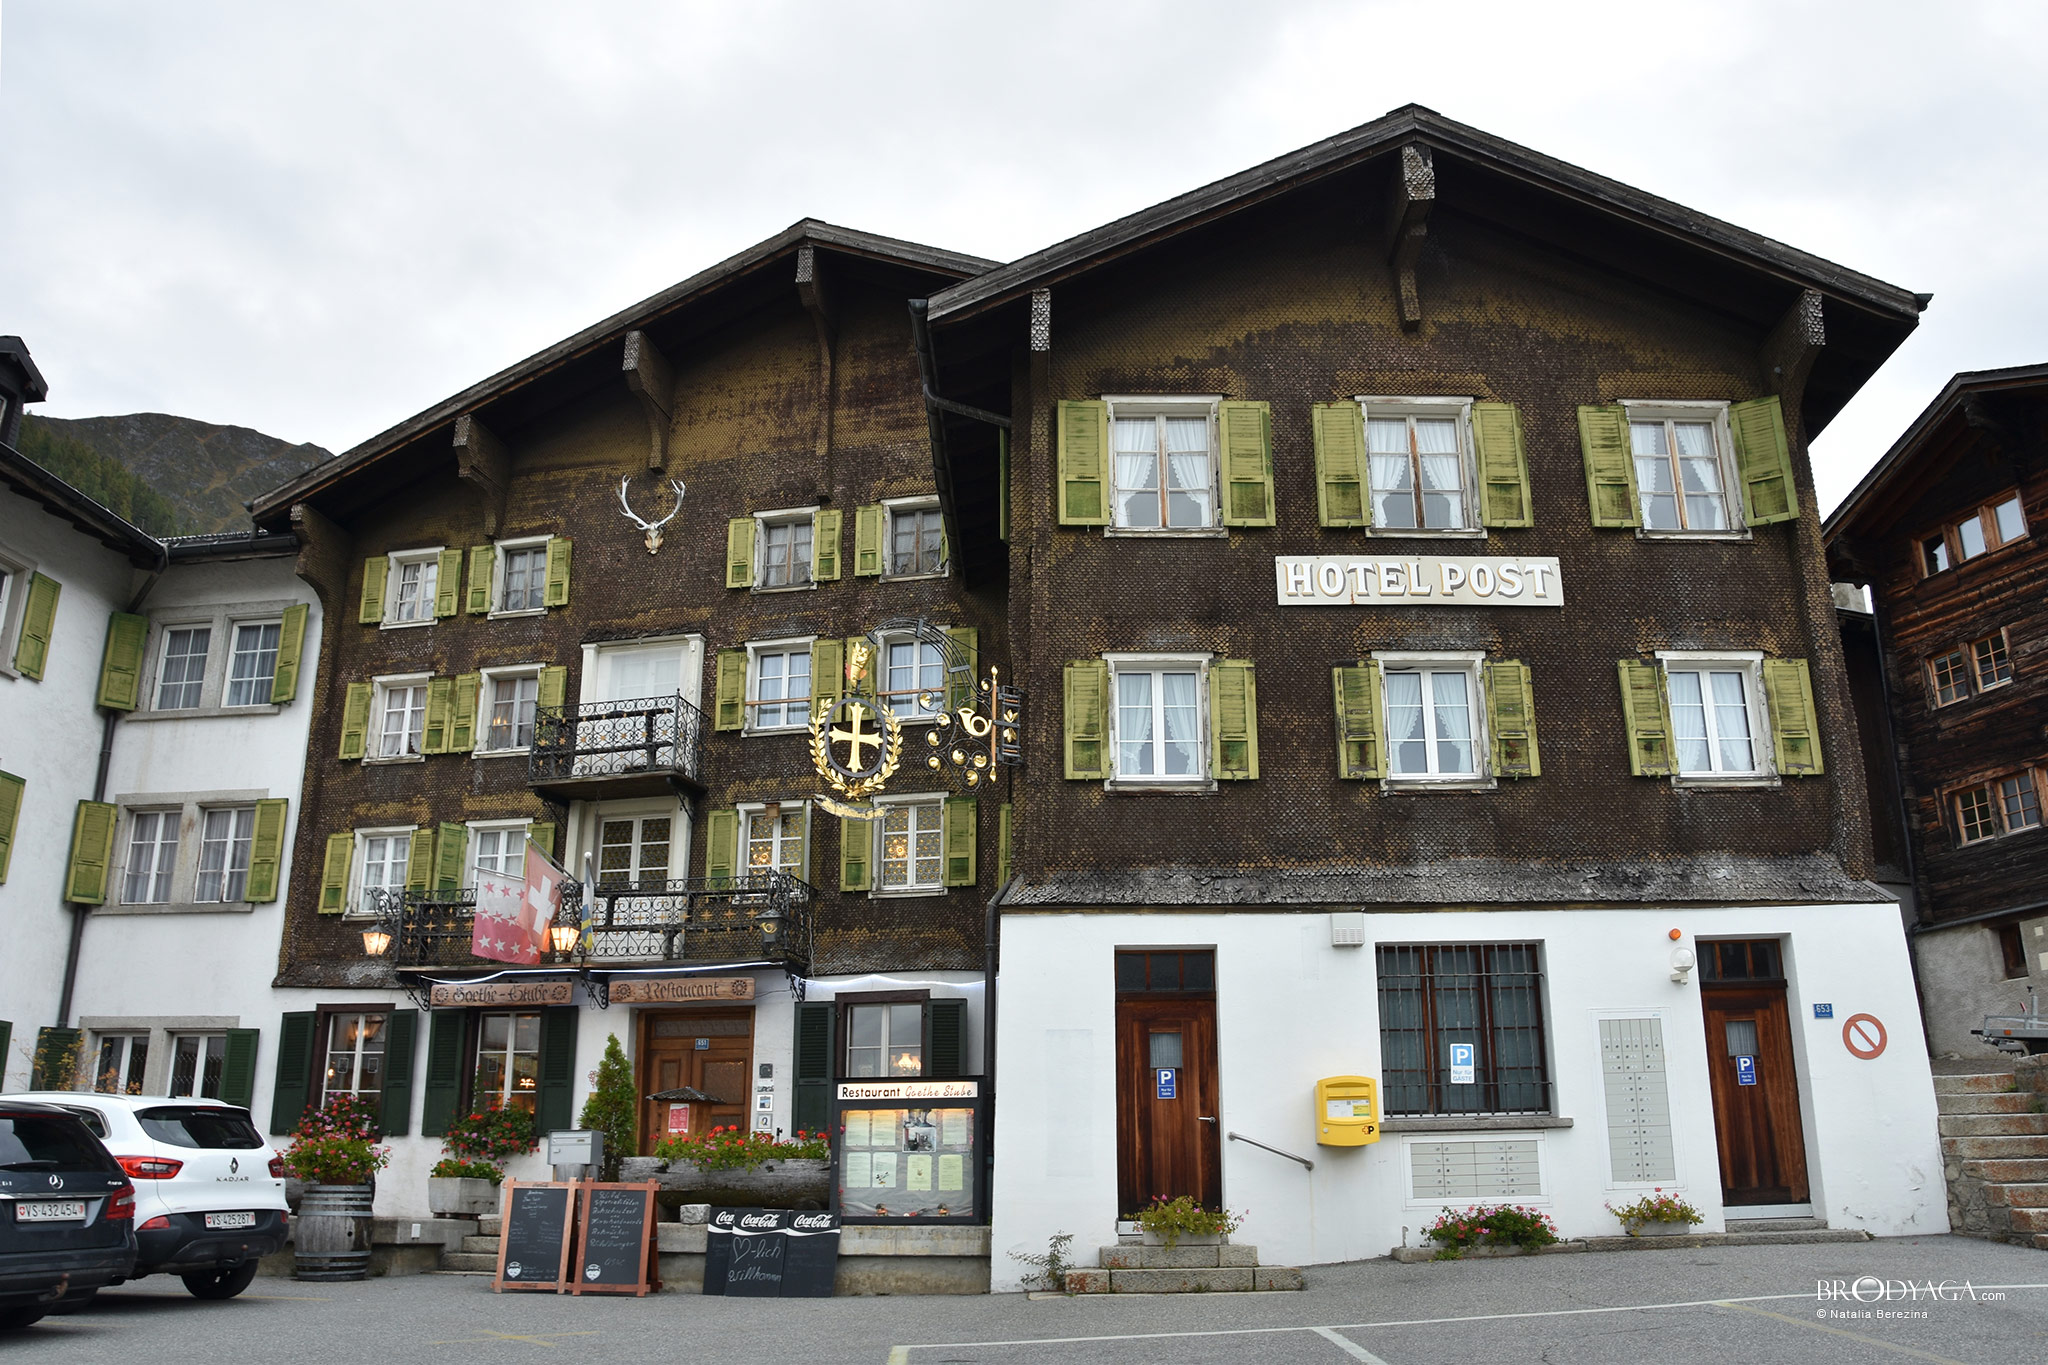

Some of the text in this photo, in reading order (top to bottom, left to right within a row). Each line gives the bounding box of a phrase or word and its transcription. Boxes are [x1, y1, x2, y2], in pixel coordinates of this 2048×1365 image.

[1284, 562, 1554, 598] HOTEL POST
[642, 981, 719, 999] Restaurant
[1815, 1004, 1830, 1013] 653
[1456, 1048, 1469, 1064] P
[1740, 1058, 1751, 1071] P
[1160, 1071, 1172, 1084] P
[842, 1085, 973, 1099] Restaurant Goethe Stube
